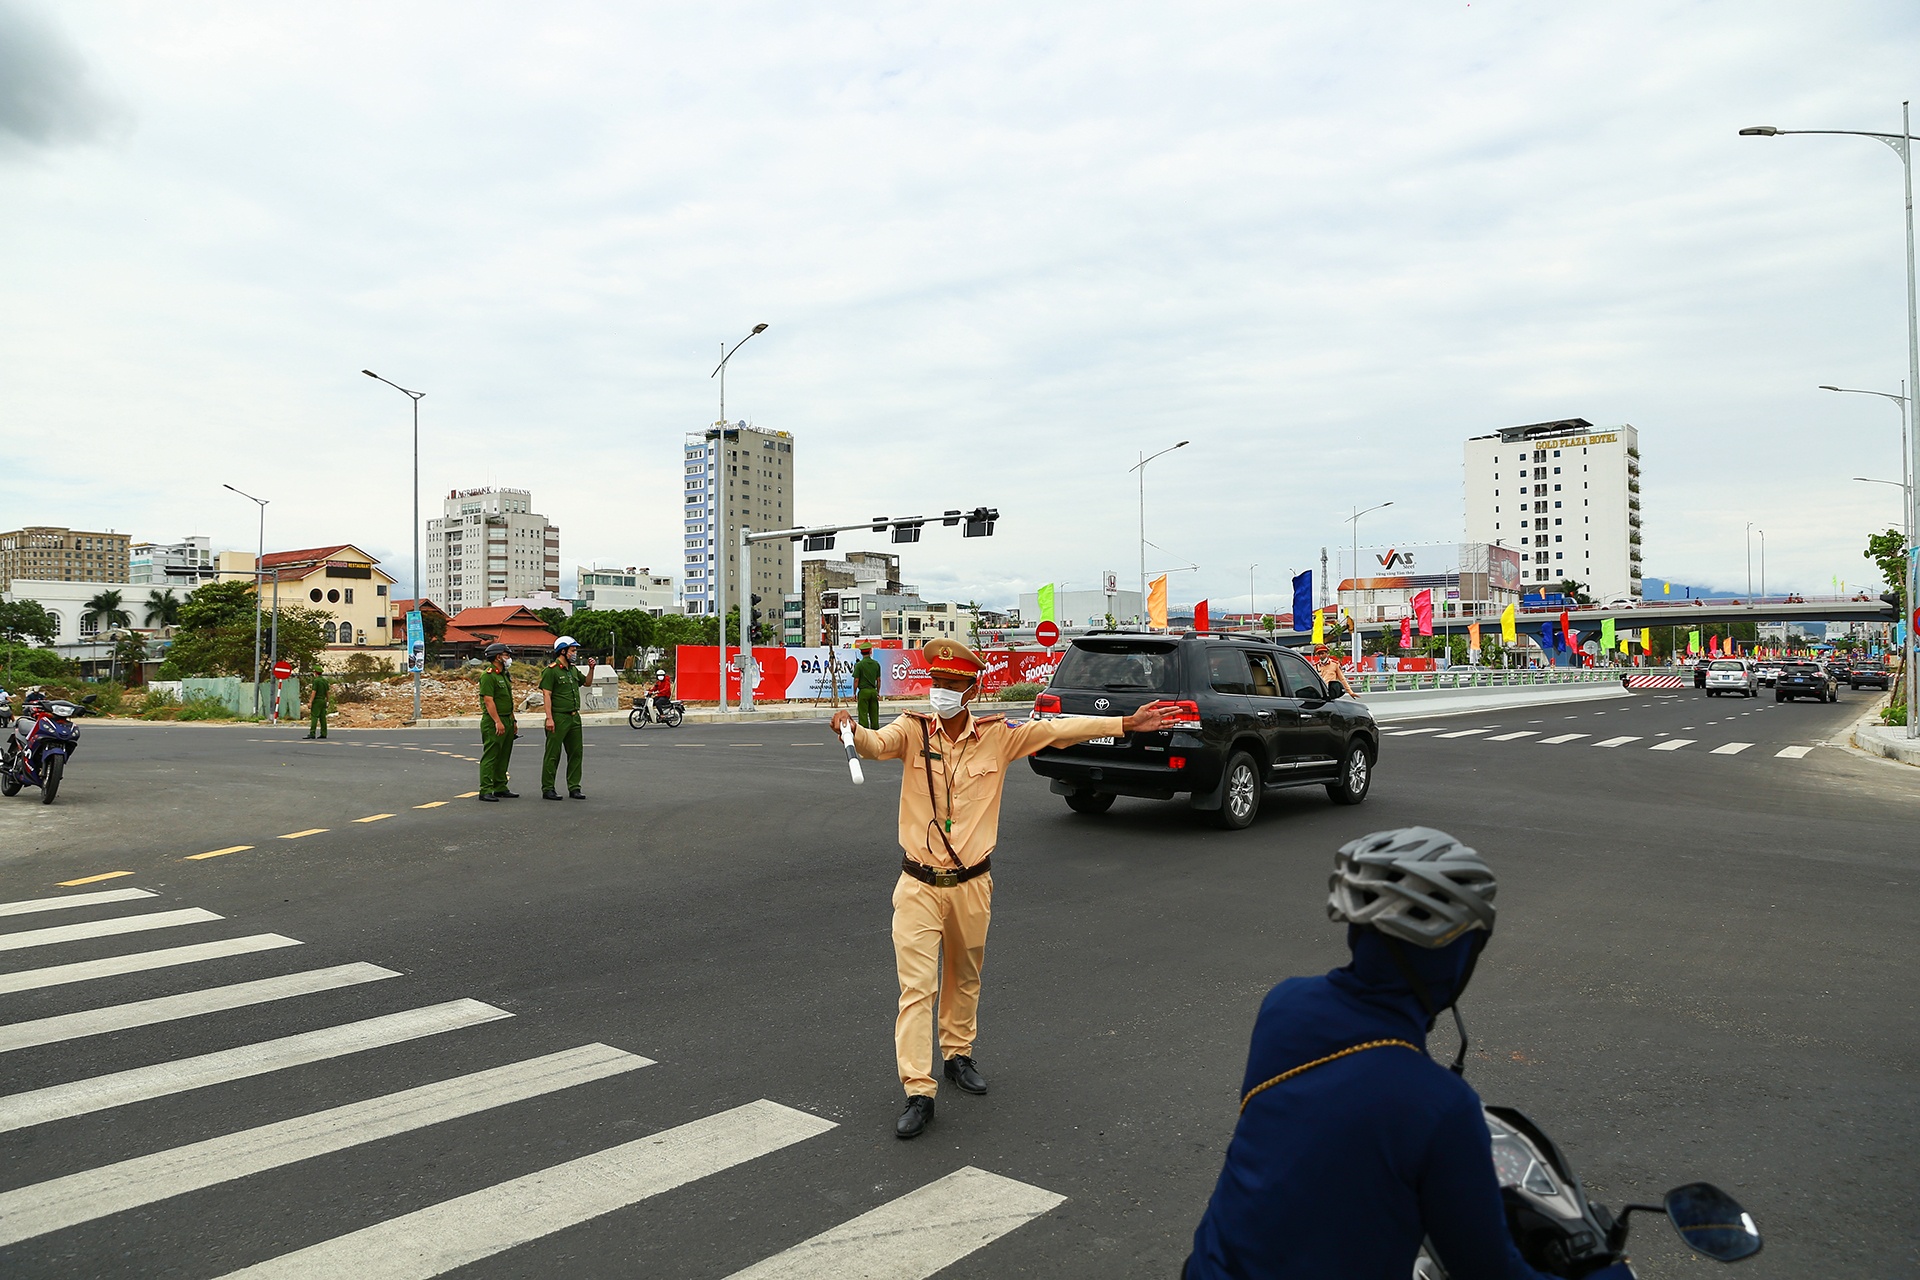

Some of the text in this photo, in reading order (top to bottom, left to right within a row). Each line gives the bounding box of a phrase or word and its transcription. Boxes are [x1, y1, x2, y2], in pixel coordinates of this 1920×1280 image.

[1536, 434, 1617, 449] GOLD PLAZA HOTEL
[458, 486, 491, 498] AGRIBANK
[1376, 549, 1414, 570] VAS
[892, 664, 907, 680] 5G
